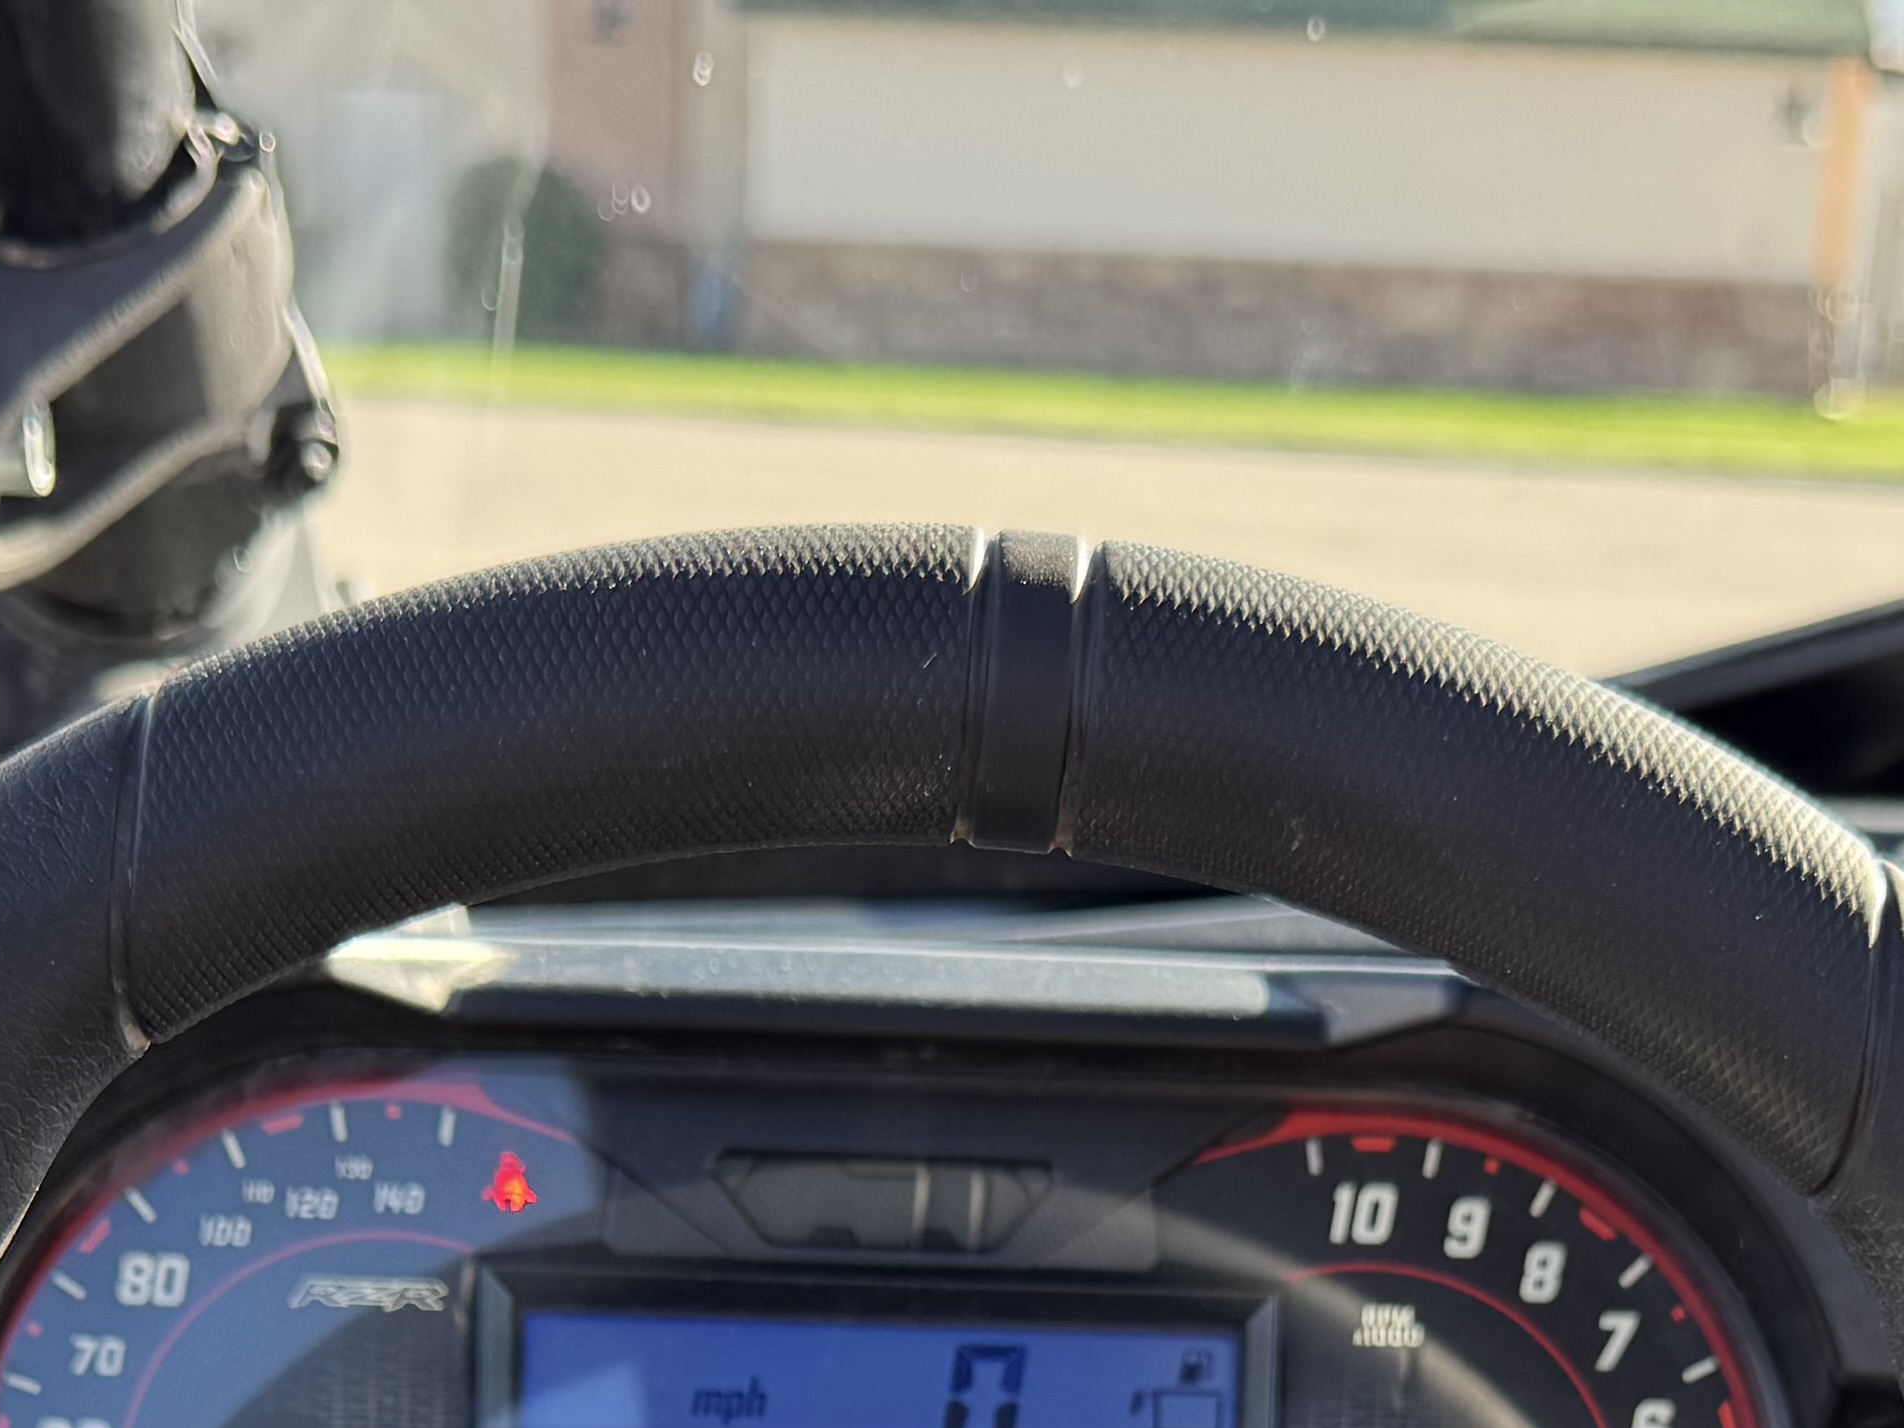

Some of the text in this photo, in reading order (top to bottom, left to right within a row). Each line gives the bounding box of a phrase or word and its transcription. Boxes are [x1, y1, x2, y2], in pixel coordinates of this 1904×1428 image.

[285, 1186, 339, 1219] 120
[373, 1182, 425, 1215] 140
[1329, 1182, 1399, 1246] 10
[199, 1215, 253, 1248] 100
[1444, 1198, 1490, 1259] 9
[116, 1252, 189, 1307] 80
[1519, 1241, 1566, 1304] 8
[70, 1336, 125, 1378] 70
[1596, 1310, 1640, 1371] 7
[691, 1375, 767, 1421] mph
